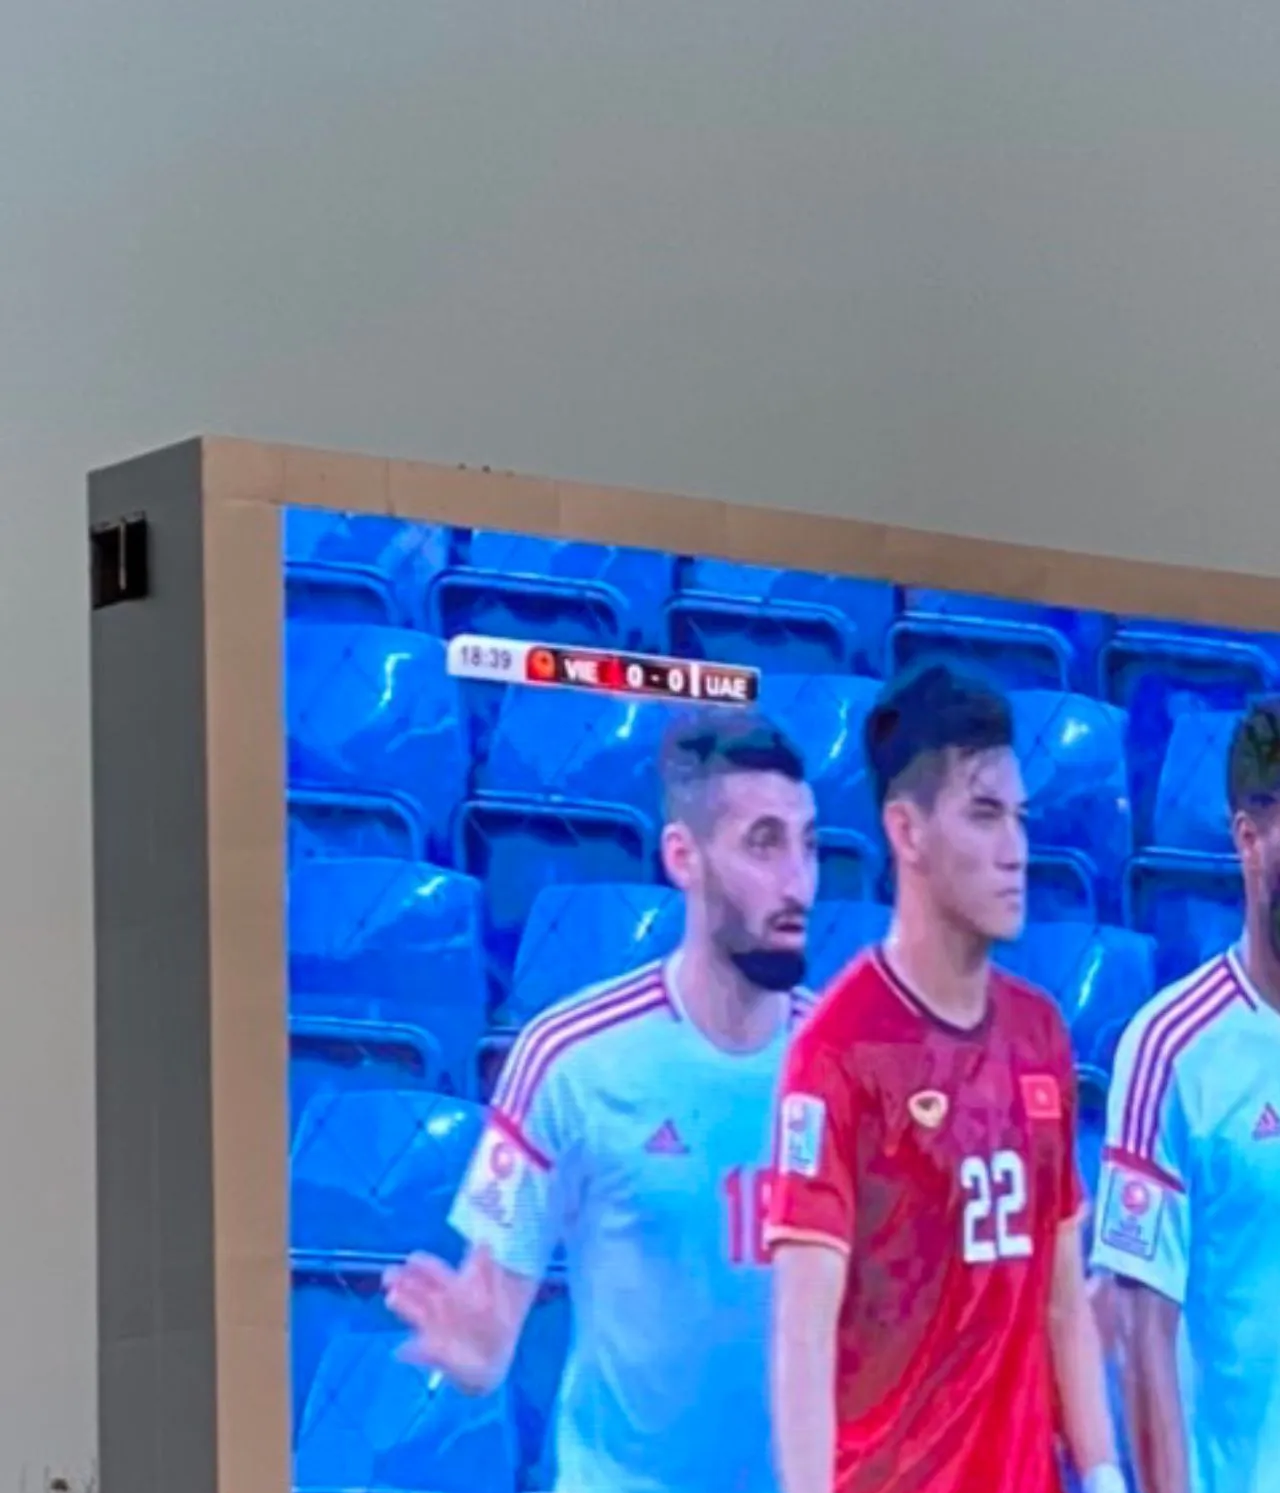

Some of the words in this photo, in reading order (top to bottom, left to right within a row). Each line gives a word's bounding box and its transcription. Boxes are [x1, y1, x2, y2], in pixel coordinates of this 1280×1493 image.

[460, 643, 512, 670] 18:39
[564, 657, 598, 681] VIE
[626, 664, 643, 688] 0
[667, 669, 684, 692] 0
[705, 675, 748, 699] UAE
[960, 1149, 1034, 1263] 22
